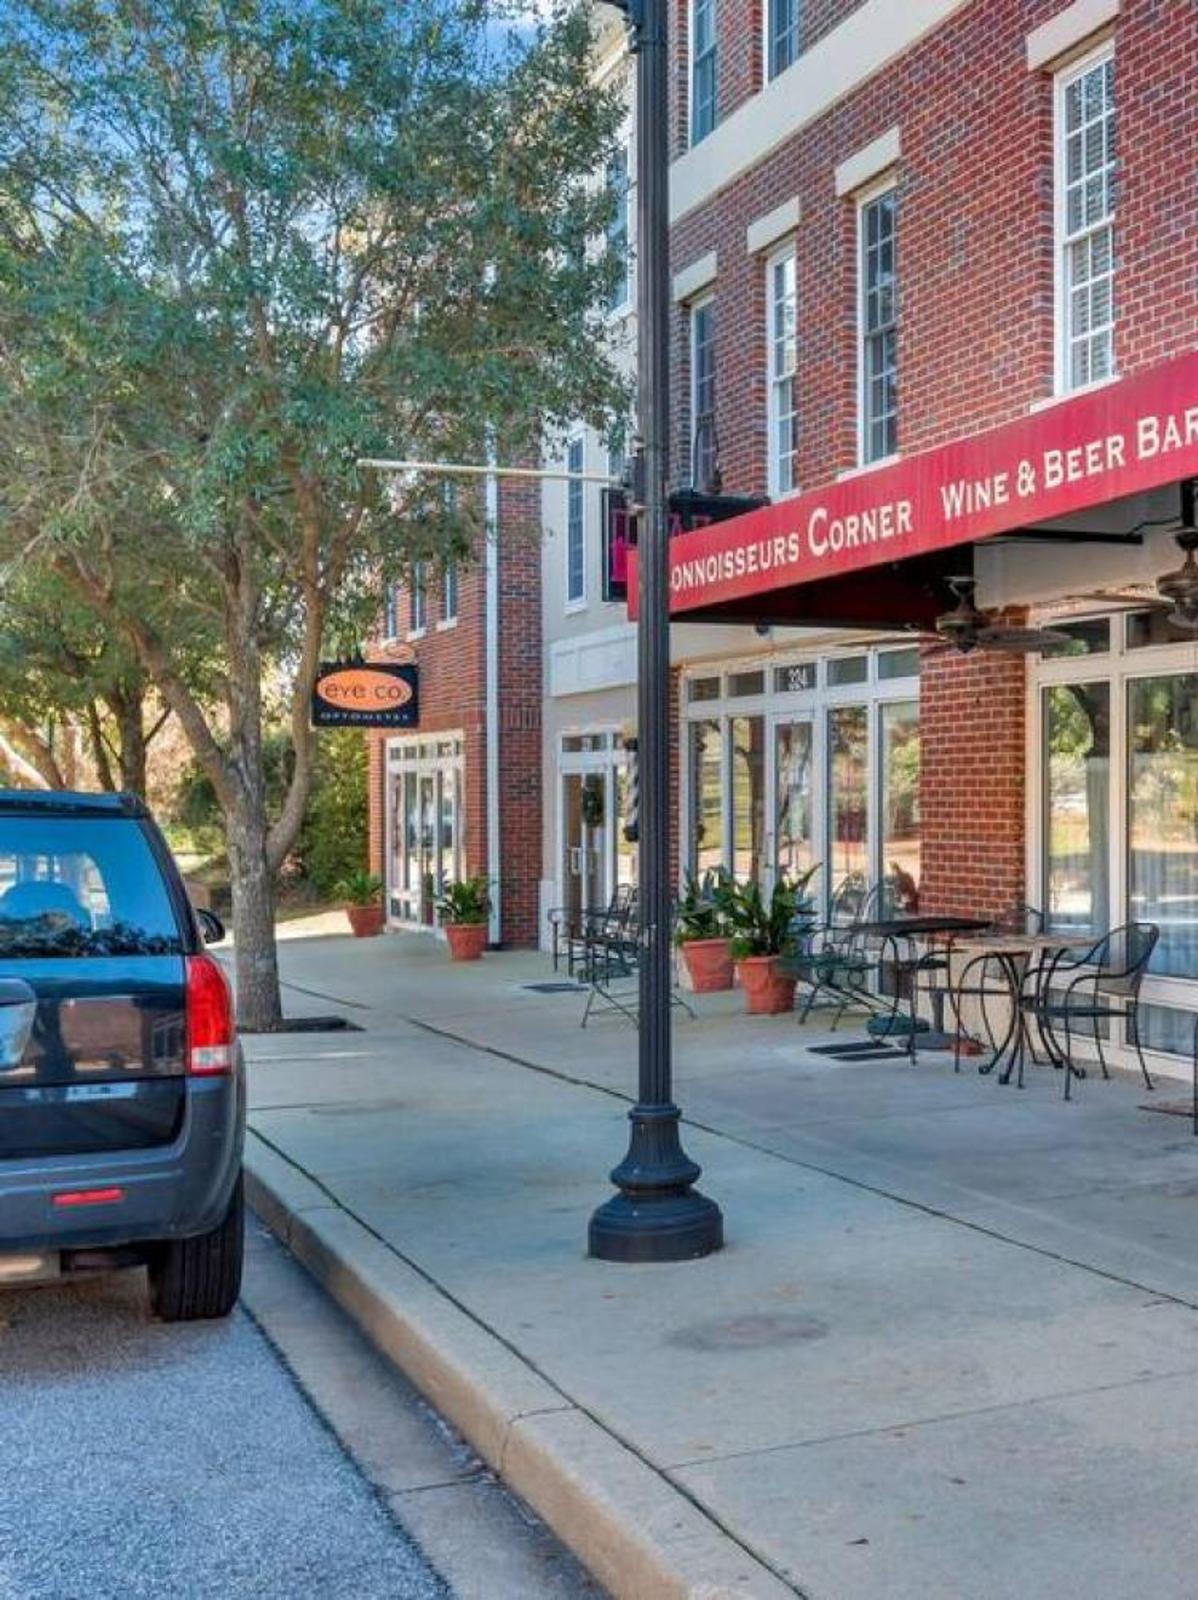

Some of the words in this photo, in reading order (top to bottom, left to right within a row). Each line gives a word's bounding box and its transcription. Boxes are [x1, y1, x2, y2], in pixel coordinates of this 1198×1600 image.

[670, 532, 799, 592] ONNOISSEURS
[807, 499, 913, 557] CORNER
[940, 471, 1010, 520] WINE
[1017, 459, 1036, 497] &
[1043, 434, 1126, 489] BEER
